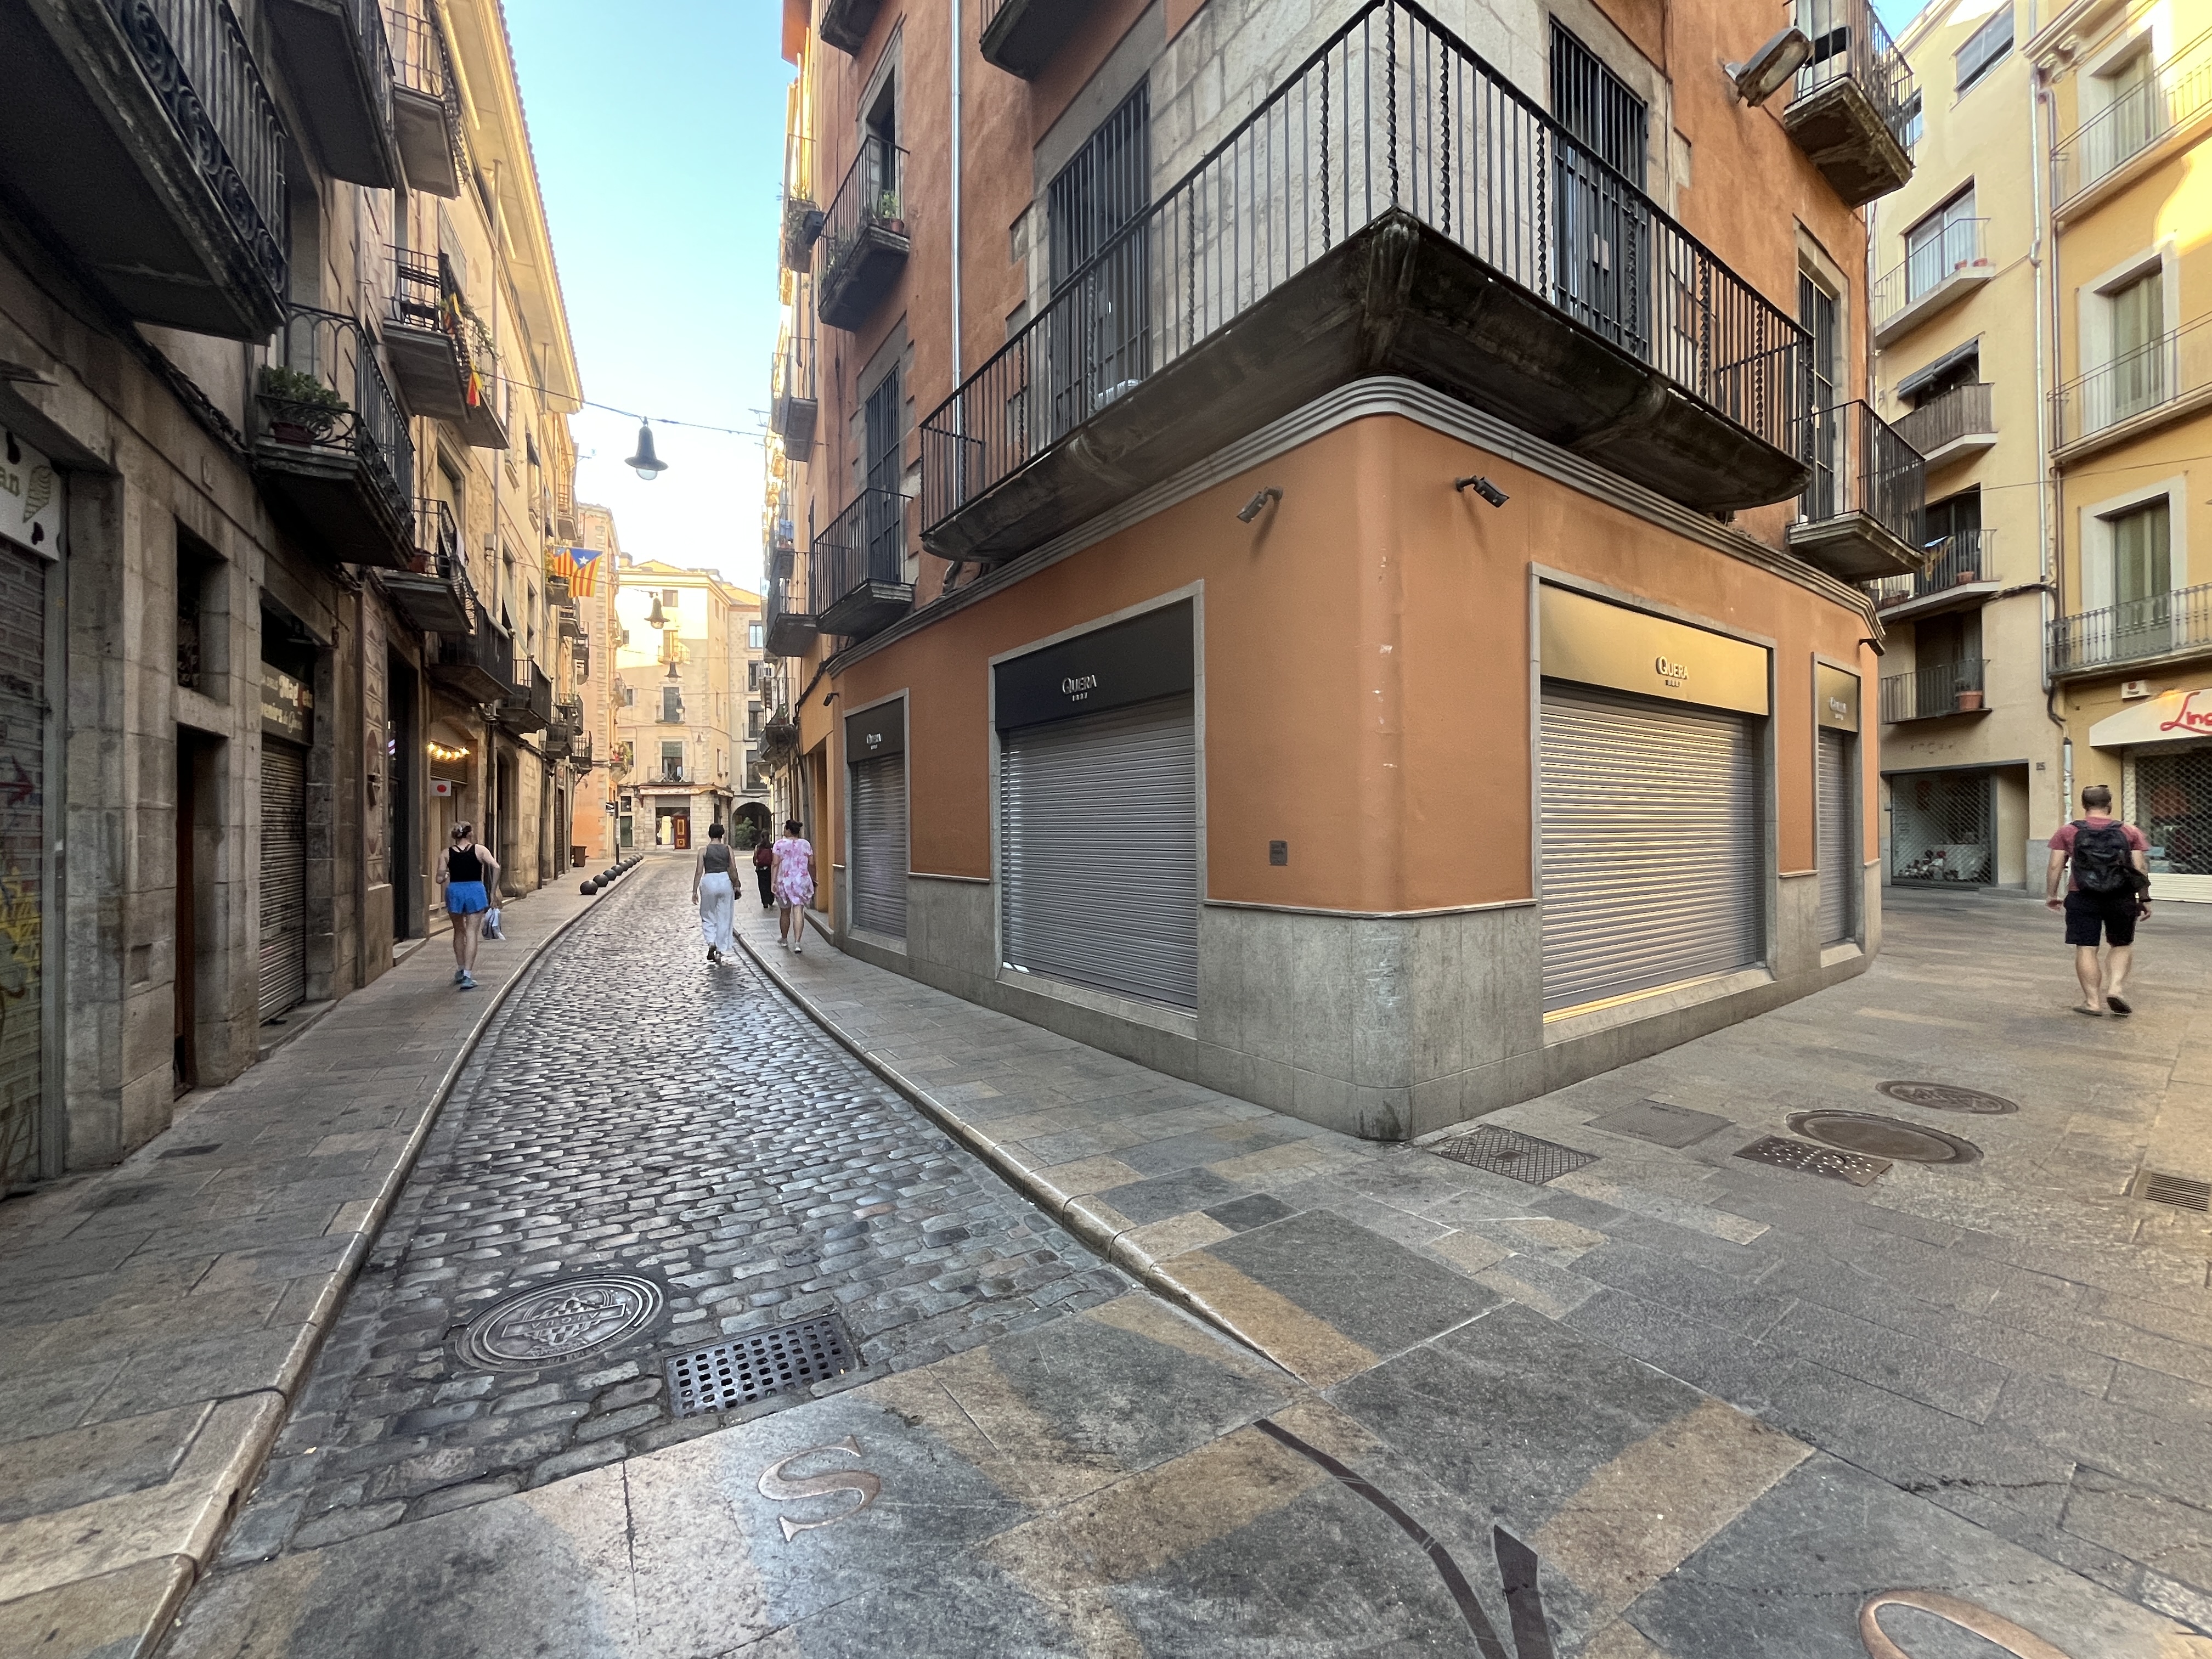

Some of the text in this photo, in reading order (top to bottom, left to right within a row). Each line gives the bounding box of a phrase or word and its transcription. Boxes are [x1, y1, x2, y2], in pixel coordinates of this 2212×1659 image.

[1062, 674, 1097, 695] QUERA
[531, 1312, 600, 1329] AIGUA
[758, 1434, 881, 1542] S
